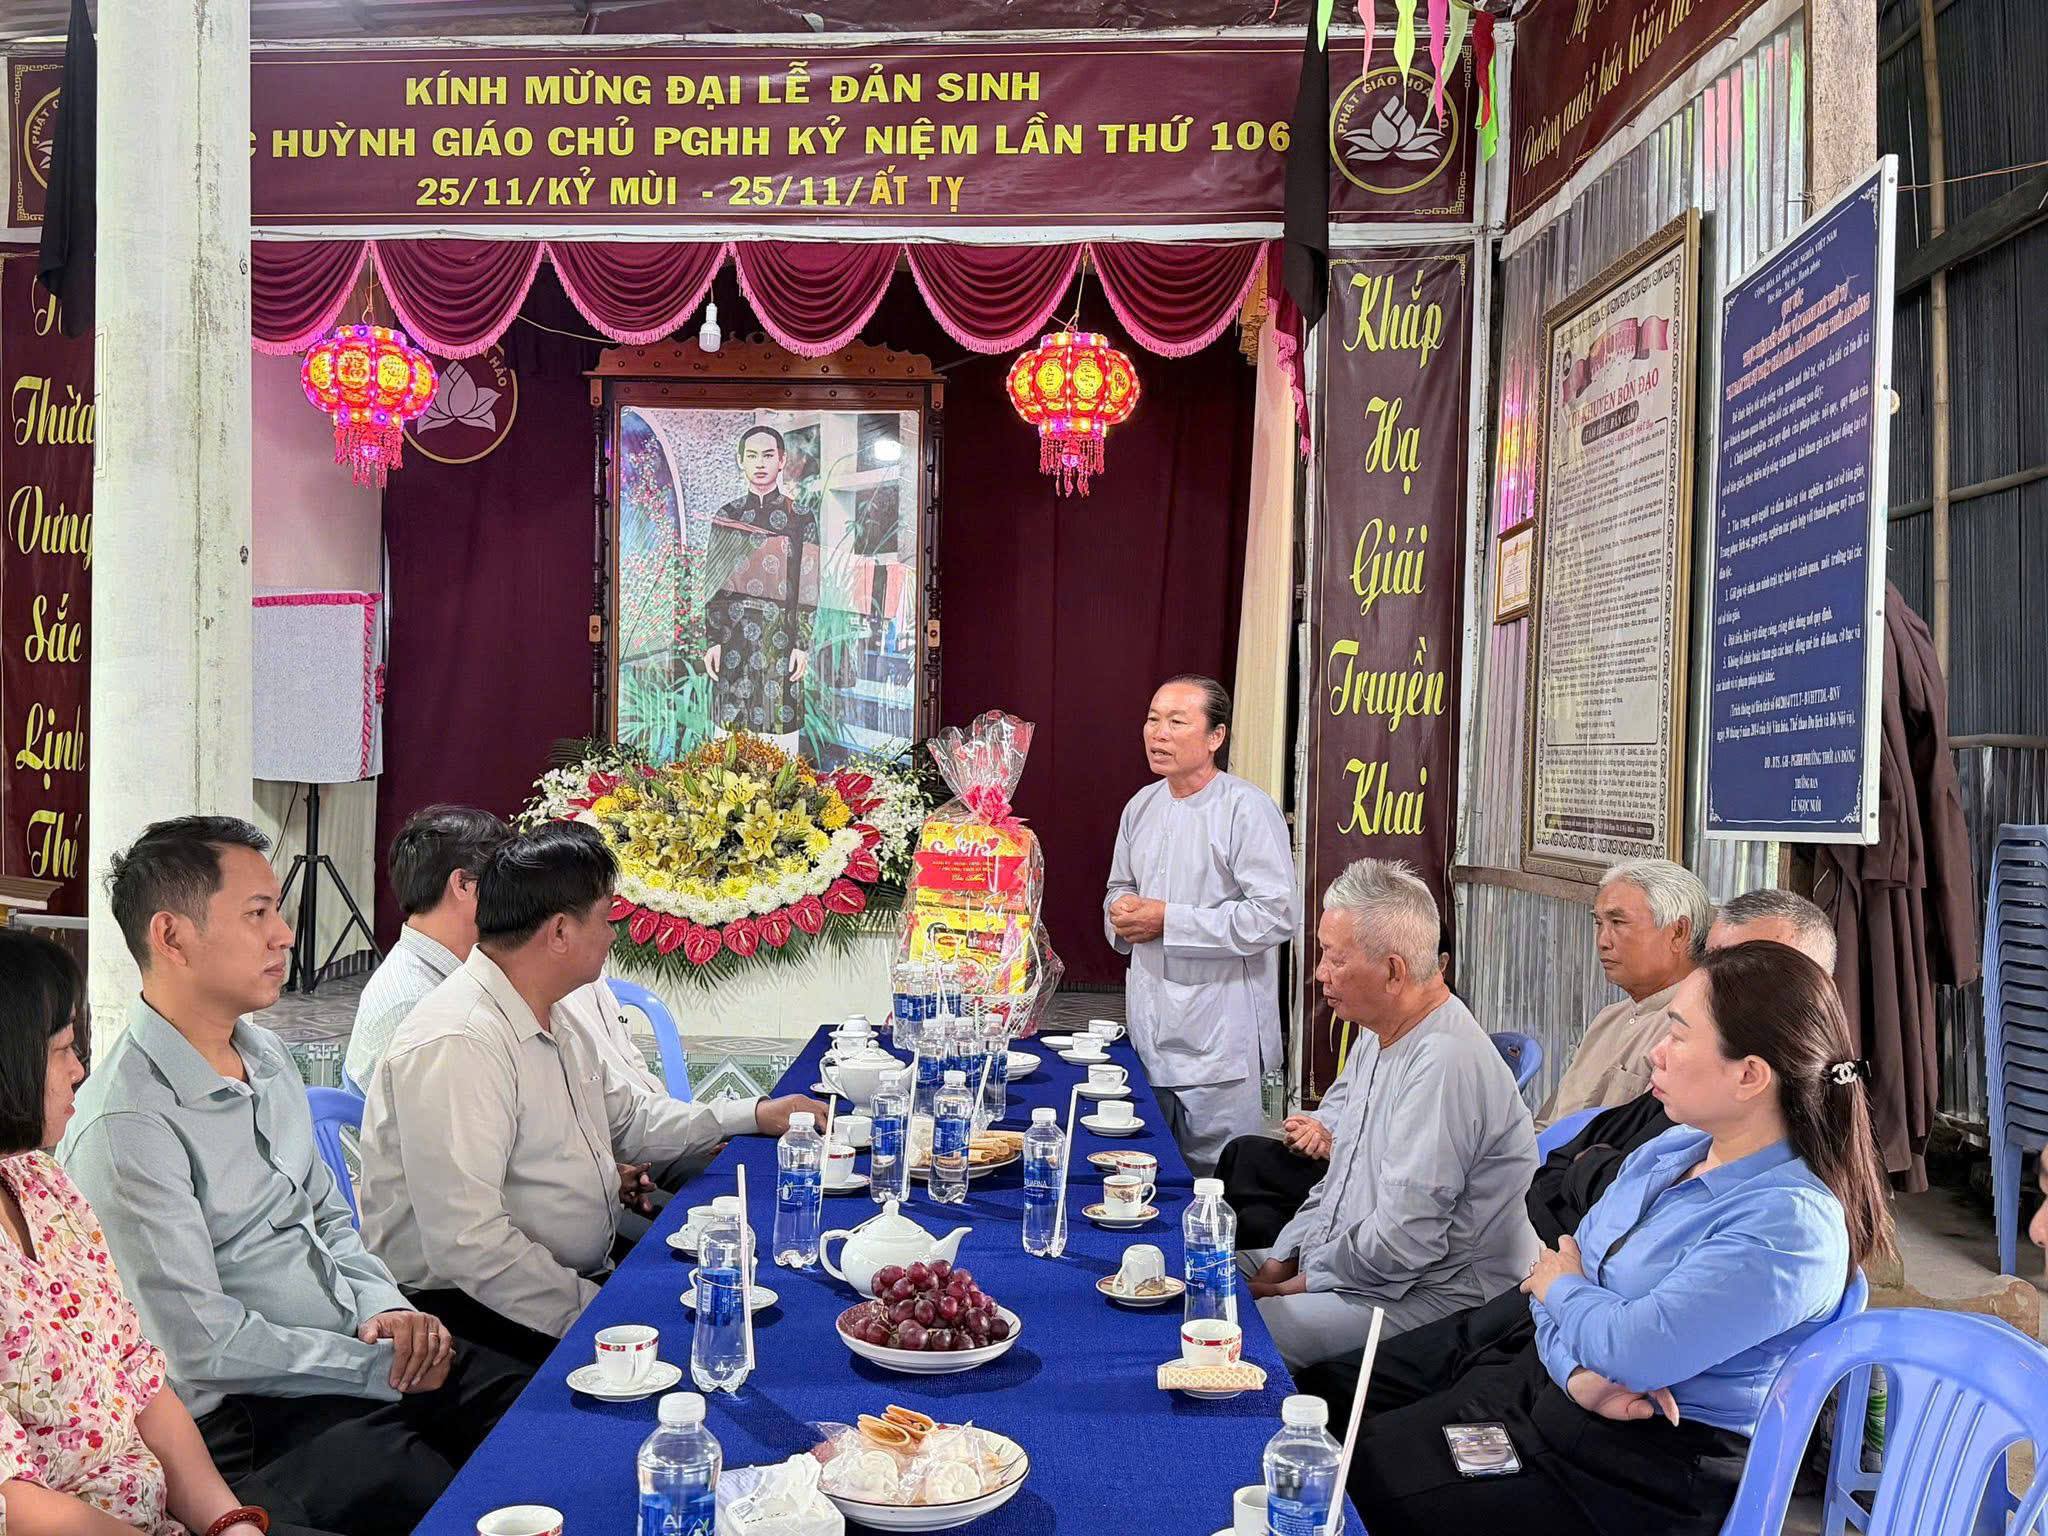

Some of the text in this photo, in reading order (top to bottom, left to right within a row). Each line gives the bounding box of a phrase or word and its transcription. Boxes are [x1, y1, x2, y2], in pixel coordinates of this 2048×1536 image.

[405, 61, 1040, 110] KÍNH MỪNG ĐẠI LỄ ĐẢN SINH
[1338, 92, 1360, 134] PHẬT
[32, 109, 49, 144] PHẬT
[272, 121, 415, 158] HUỲNH
[431, 119, 533, 156] GIÁO
[548, 115, 634, 156] CHỦ
[654, 126, 770, 156] PGHH
[788, 114, 847, 155] KỶ
[865, 117, 977, 160] NIỆM
[995, 111, 1082, 155] LẦN
[1097, 114, 1194, 154] THỨ
[1211, 121, 1291, 152] 106
[416, 166, 596, 206] 25/11/KỶ
[610, 170, 677, 205] MÙI
[729, 164, 908, 207] 25/11/ẤT
[927, 175, 965, 213] TỴ
[1342, 269, 1445, 369] Khắp
[489, 356, 507, 387] HẢO
[11, 375, 95, 445] Thừa
[1365, 396, 1422, 495] Hạ
[25, 593, 83, 663] Sắc
[1327, 637, 1446, 733] Truyền
[15, 702, 85, 791] Lịnh
[1337, 758, 1426, 836] Khai
